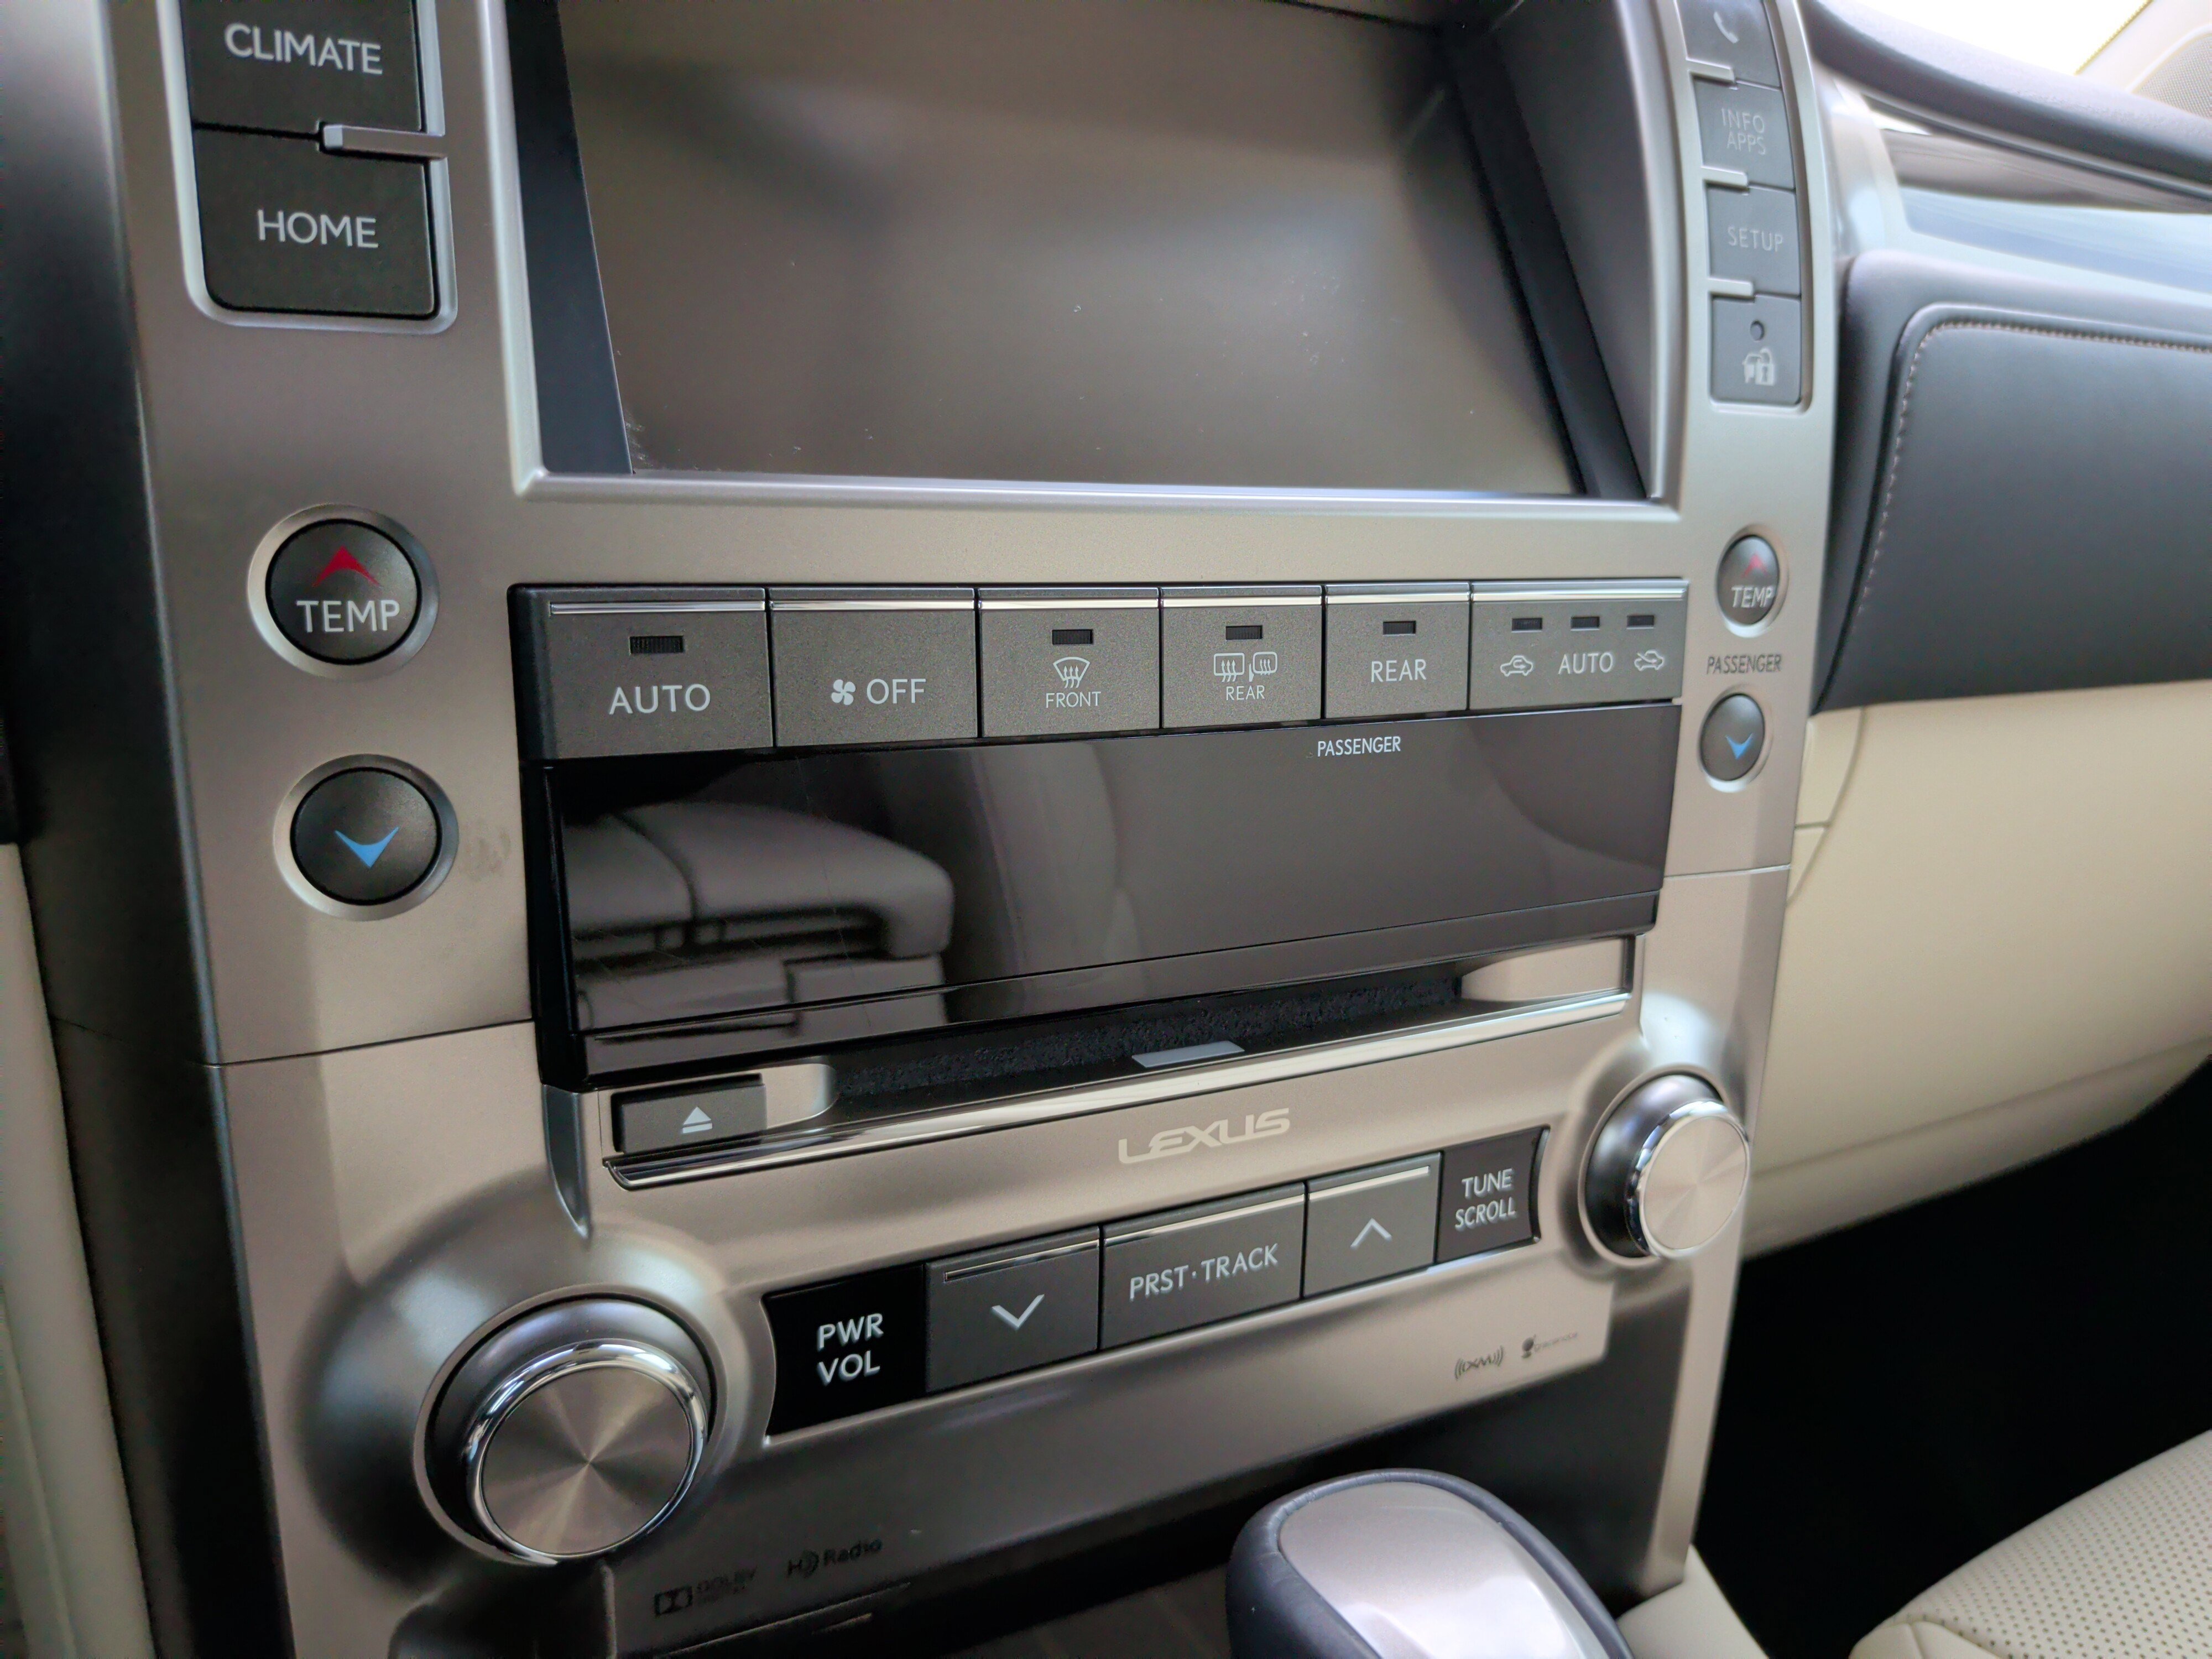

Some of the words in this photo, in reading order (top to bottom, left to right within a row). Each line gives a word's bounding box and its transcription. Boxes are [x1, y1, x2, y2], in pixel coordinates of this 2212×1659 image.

[225, 23, 383, 75] CLIMATE
[1721, 108, 1765, 134] INFO
[1726, 133, 1766, 155] APPS
[257, 209, 379, 248] HOME
[1728, 226, 1783, 252] SETUP
[1731, 586, 1774, 608] TEMP
[296, 599, 400, 632] TEMP
[1370, 659, 1427, 683] REAR
[1558, 652, 1614, 675] AUTO
[1707, 654, 1782, 674] PASSENGER
[609, 684, 711, 714] AUTO
[866, 679, 926, 705] OFF
[1046, 691, 1101, 708] FRONT
[1225, 685, 1265, 701] REAR
[1317, 736, 1401, 757] PASSENGER
[1118, 1108, 1290, 1164] LEXUS
[1462, 1167, 1513, 1199] TUNE
[1454, 1197, 1517, 1232] SCROLL
[817, 1313, 884, 1351] PWR
[817, 1350, 880, 1385] VOL
